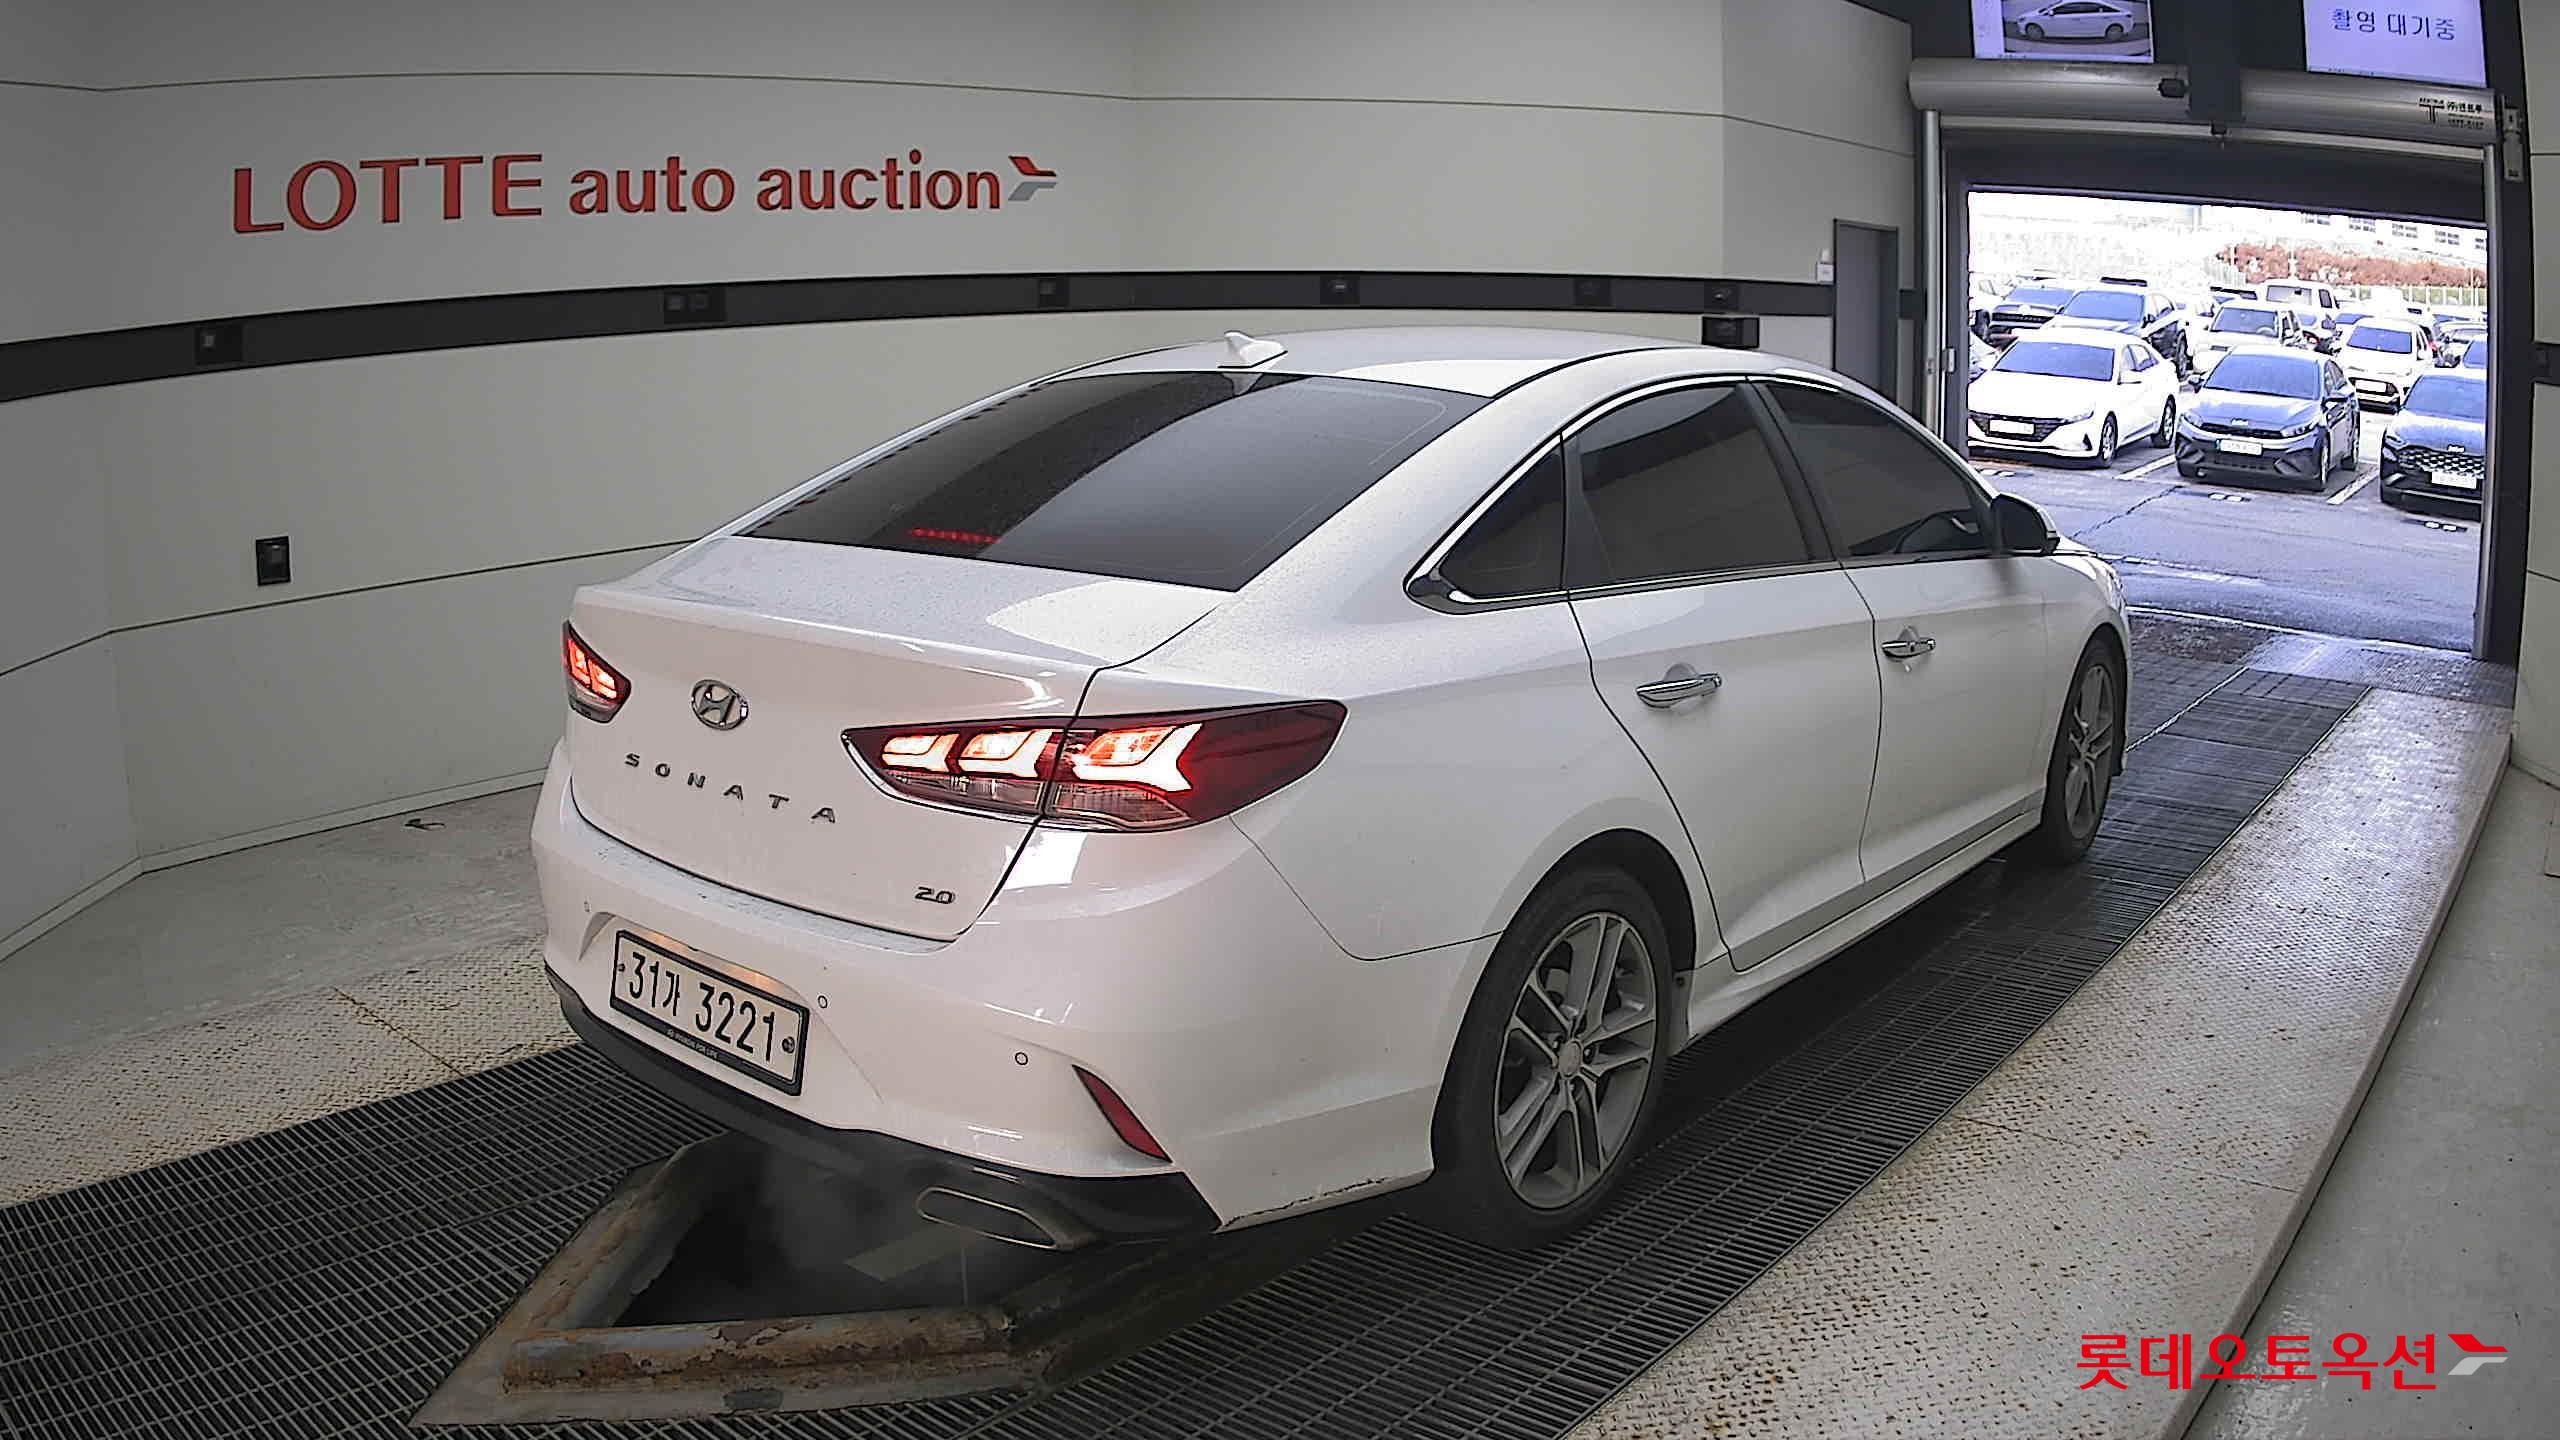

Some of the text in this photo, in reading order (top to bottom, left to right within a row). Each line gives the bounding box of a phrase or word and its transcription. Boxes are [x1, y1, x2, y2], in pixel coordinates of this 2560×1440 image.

[2332, 8, 2455, 41] 촬영 대기중
[234, 148, 1001, 234] LOTTE auto auction
[624, 752, 836, 824] SONATA
[629, 951, 681, 1017] 31가
[695, 982, 775, 1062] 3221
